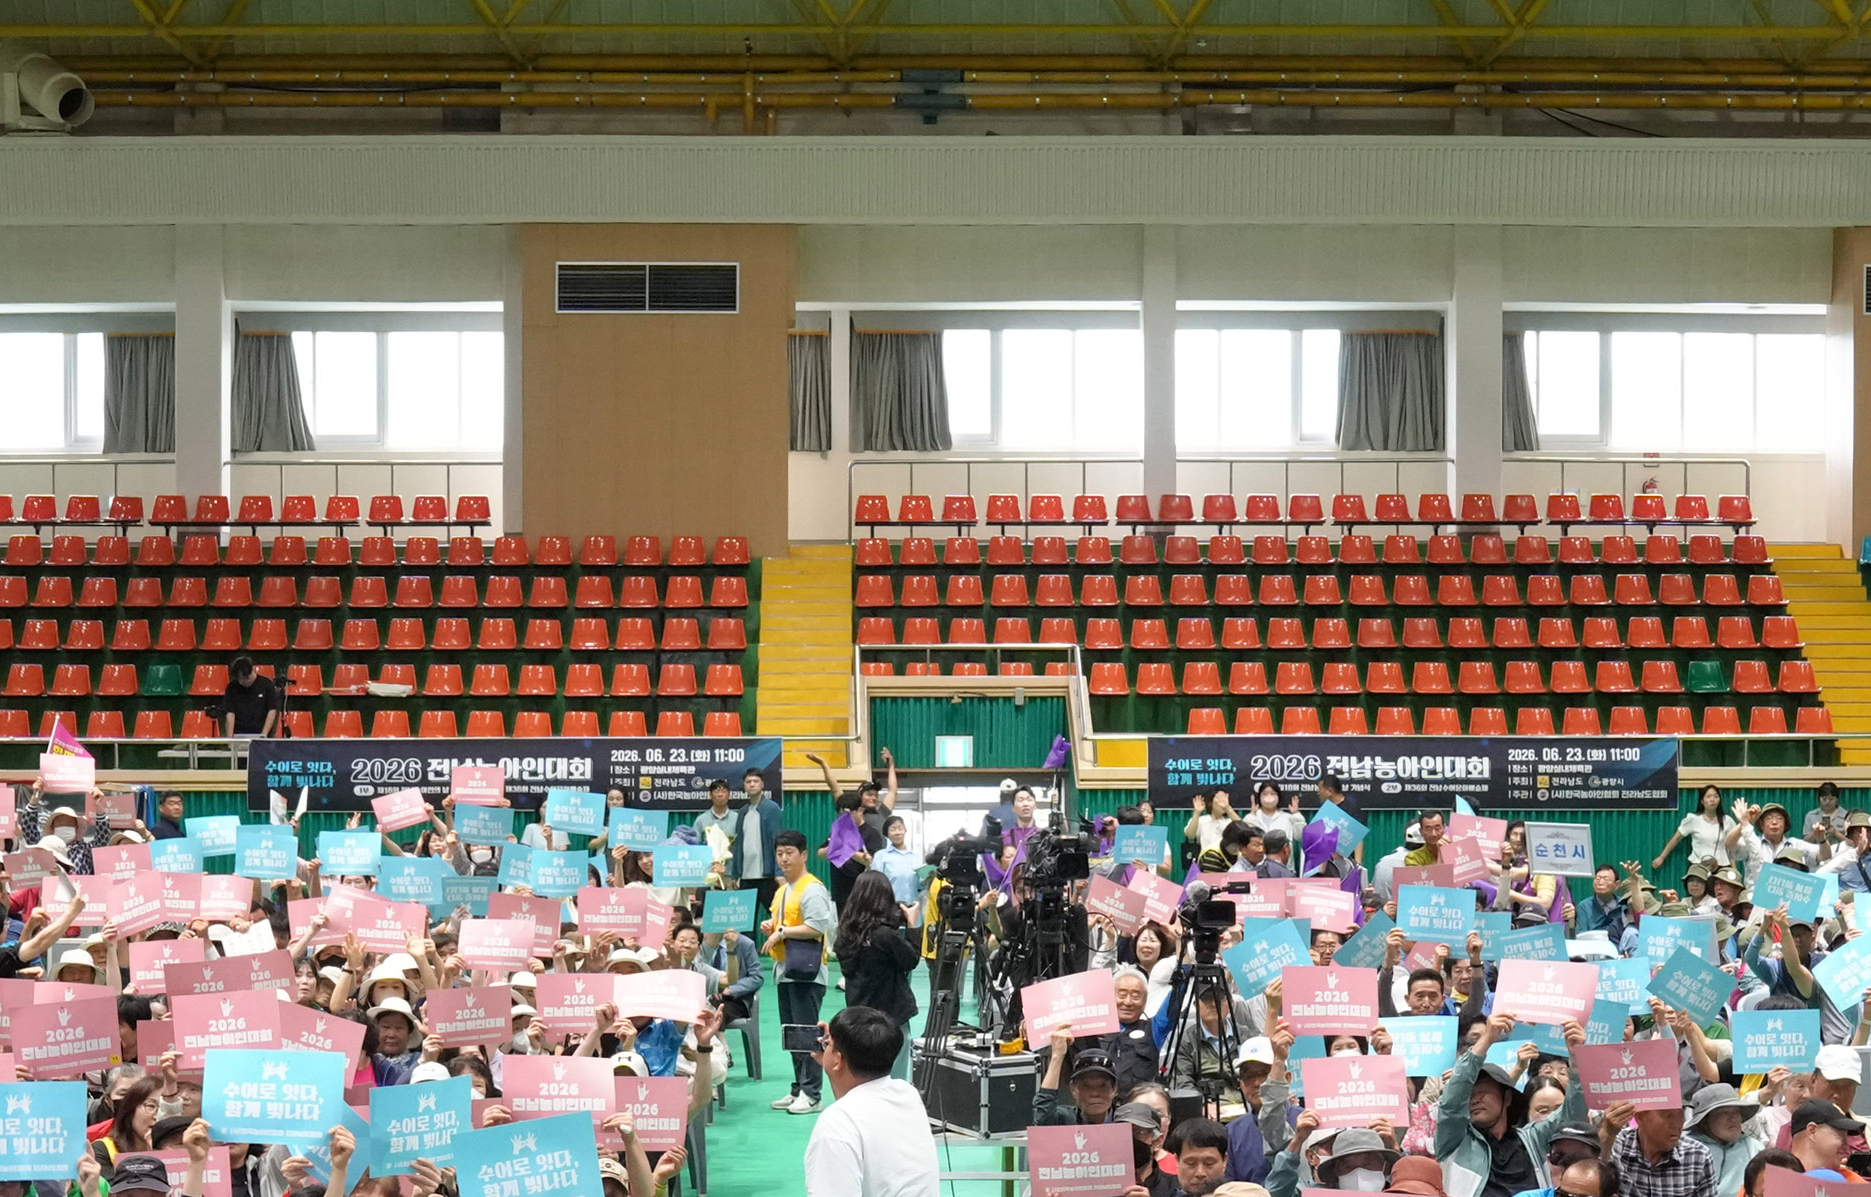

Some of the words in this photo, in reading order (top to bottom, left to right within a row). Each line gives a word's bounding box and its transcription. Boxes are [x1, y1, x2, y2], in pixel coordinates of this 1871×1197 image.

[610, 749, 641, 763] 2026.
[645, 748, 666, 763] 06.
[714, 748, 745, 763] 11:00
[1508, 748, 1539, 762] 2026.
[1542, 747, 1563, 762] 06.
[1610, 747, 1641, 762] 11:00
[265, 760, 303, 774] 수어로
[307, 760, 337, 775] 잇다,
[350, 757, 422, 784] 2026
[1165, 758, 1203, 772] 수어로
[1206, 758, 1237, 773] 잇다,
[1250, 754, 1322, 781] 2026
[1326, 755, 1491, 782] 전남농아인대회
[267, 775, 292, 788] 함께
[296, 774, 334, 788] 빛나다
[1167, 772, 1192, 786] 함께
[1196, 772, 1234, 786] 빛나다
[1535, 843, 1585, 859] 순천시
[478, 1158, 531, 1180] 수어로
[536, 1150, 580, 1170] 잇다,
[526, 1168, 579, 1193] 빛나다
